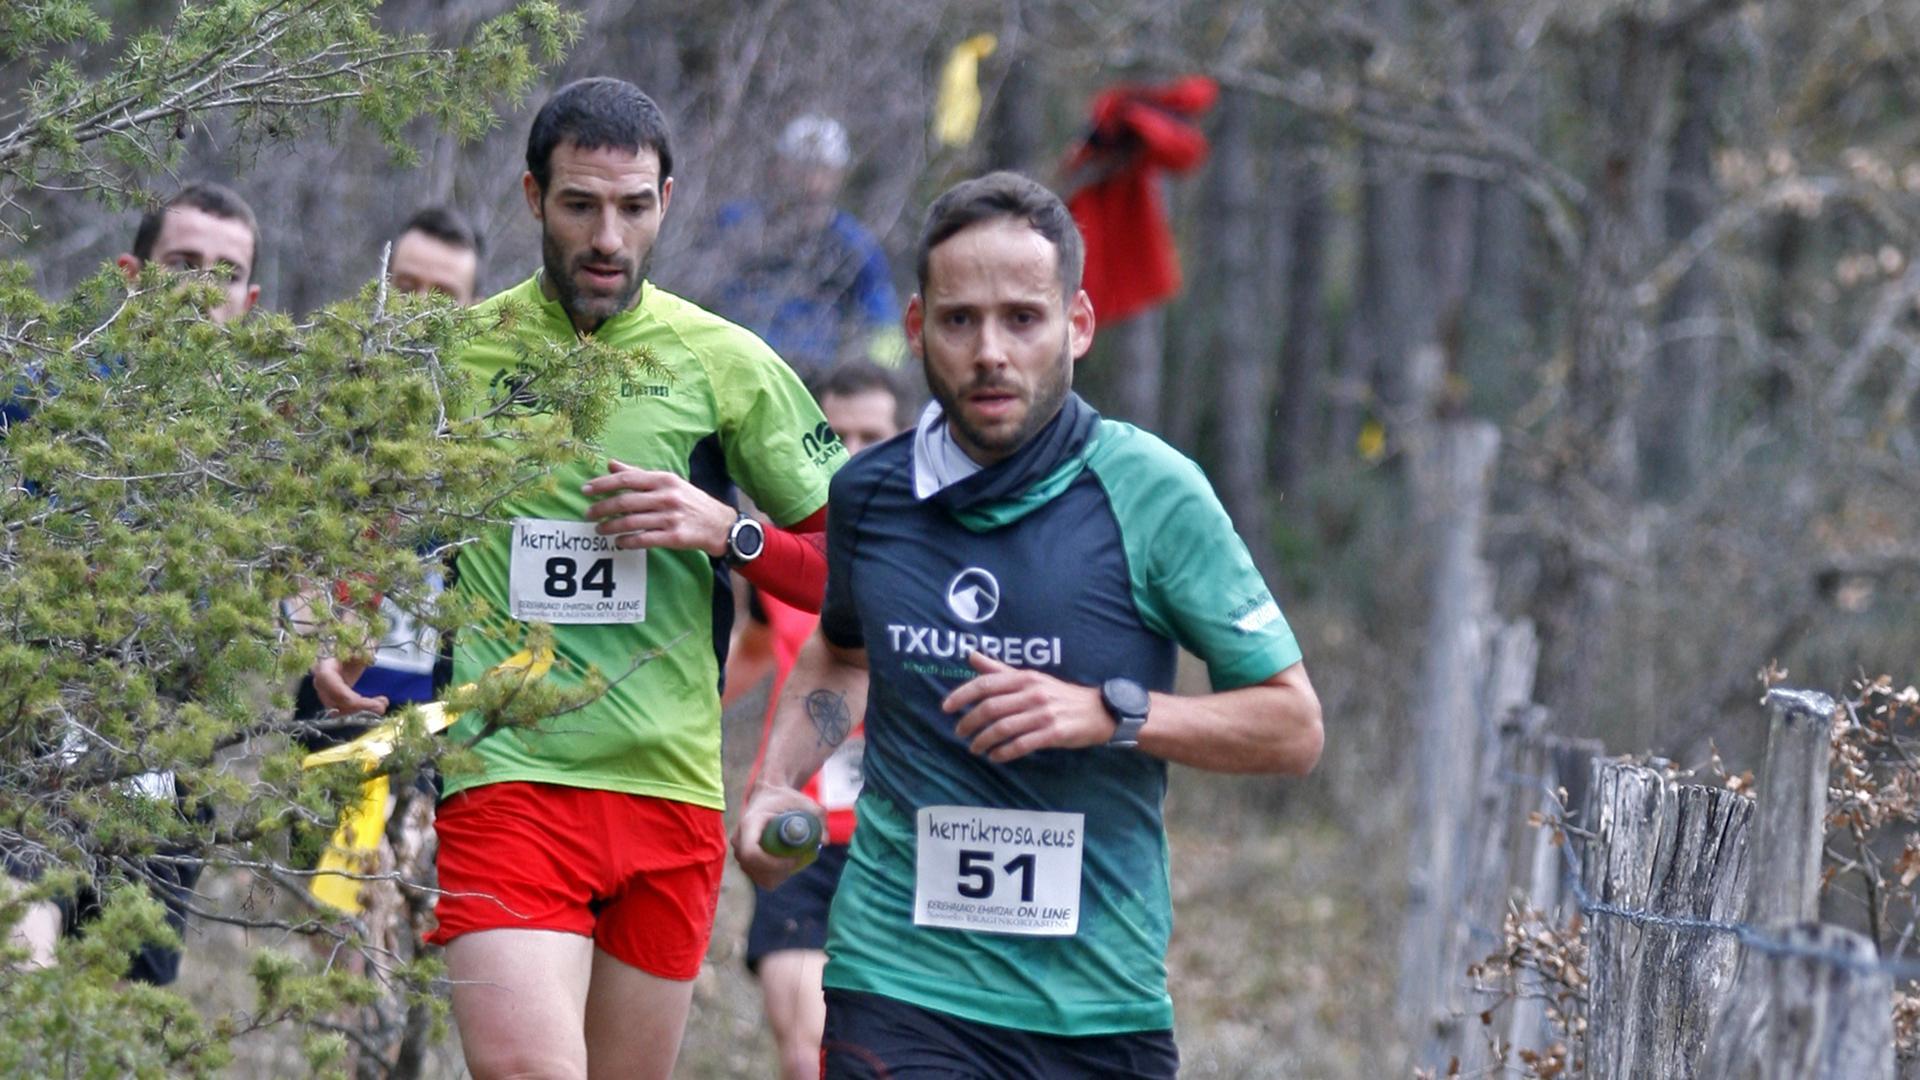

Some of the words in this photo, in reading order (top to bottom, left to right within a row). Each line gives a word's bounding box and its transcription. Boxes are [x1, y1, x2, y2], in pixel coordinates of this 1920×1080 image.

[813, 441, 843, 468] PLATA
[520, 526, 624, 551] herrikrosa.
[544, 556, 616, 599] 84
[596, 601, 614, 611] ON
[617, 600, 641, 611] LINE
[887, 624, 1062, 665] TXURREGI
[928, 813, 1076, 848] herrikrosa.eus
[957, 849, 1036, 903] 51
[1017, 906, 1038, 918] ON
[1042, 907, 1071, 920] LINE
